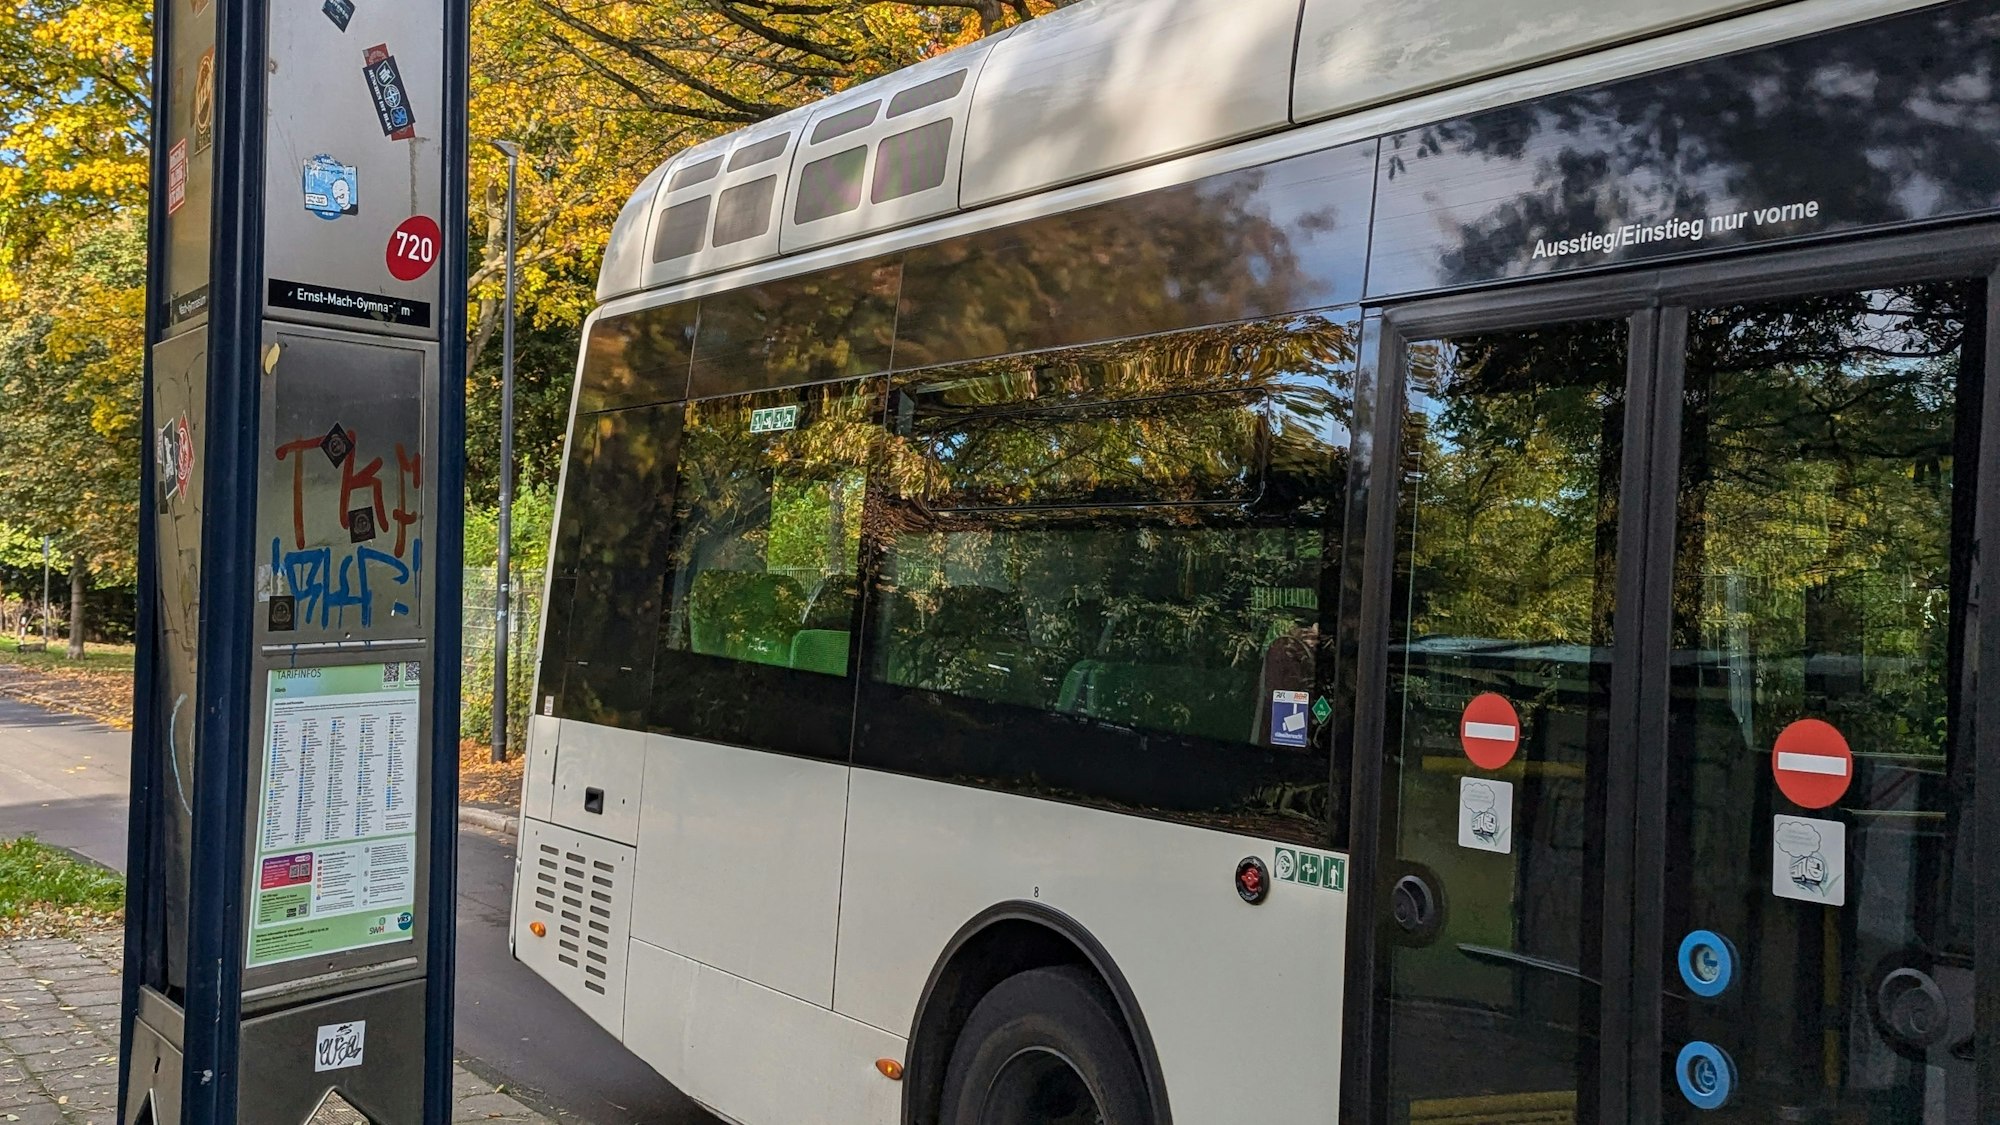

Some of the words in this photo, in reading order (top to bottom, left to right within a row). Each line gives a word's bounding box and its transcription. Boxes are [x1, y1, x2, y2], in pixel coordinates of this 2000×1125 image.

[382, 112, 393, 131] BLAU
[1531, 217, 1704, 260] Ausstieg/Einstieg
[1710, 210, 1748, 233] nur
[1753, 199, 1819, 226] vorne
[396, 230, 433, 263] 720
[296, 287, 411, 317] Ernst-Mach-Gymnam
[276, 668, 322, 680] TARIFINFOS
[1033, 886, 1040, 898] 8
[397, 915, 409, 923] VRS
[368, 925, 385, 935] SWH
